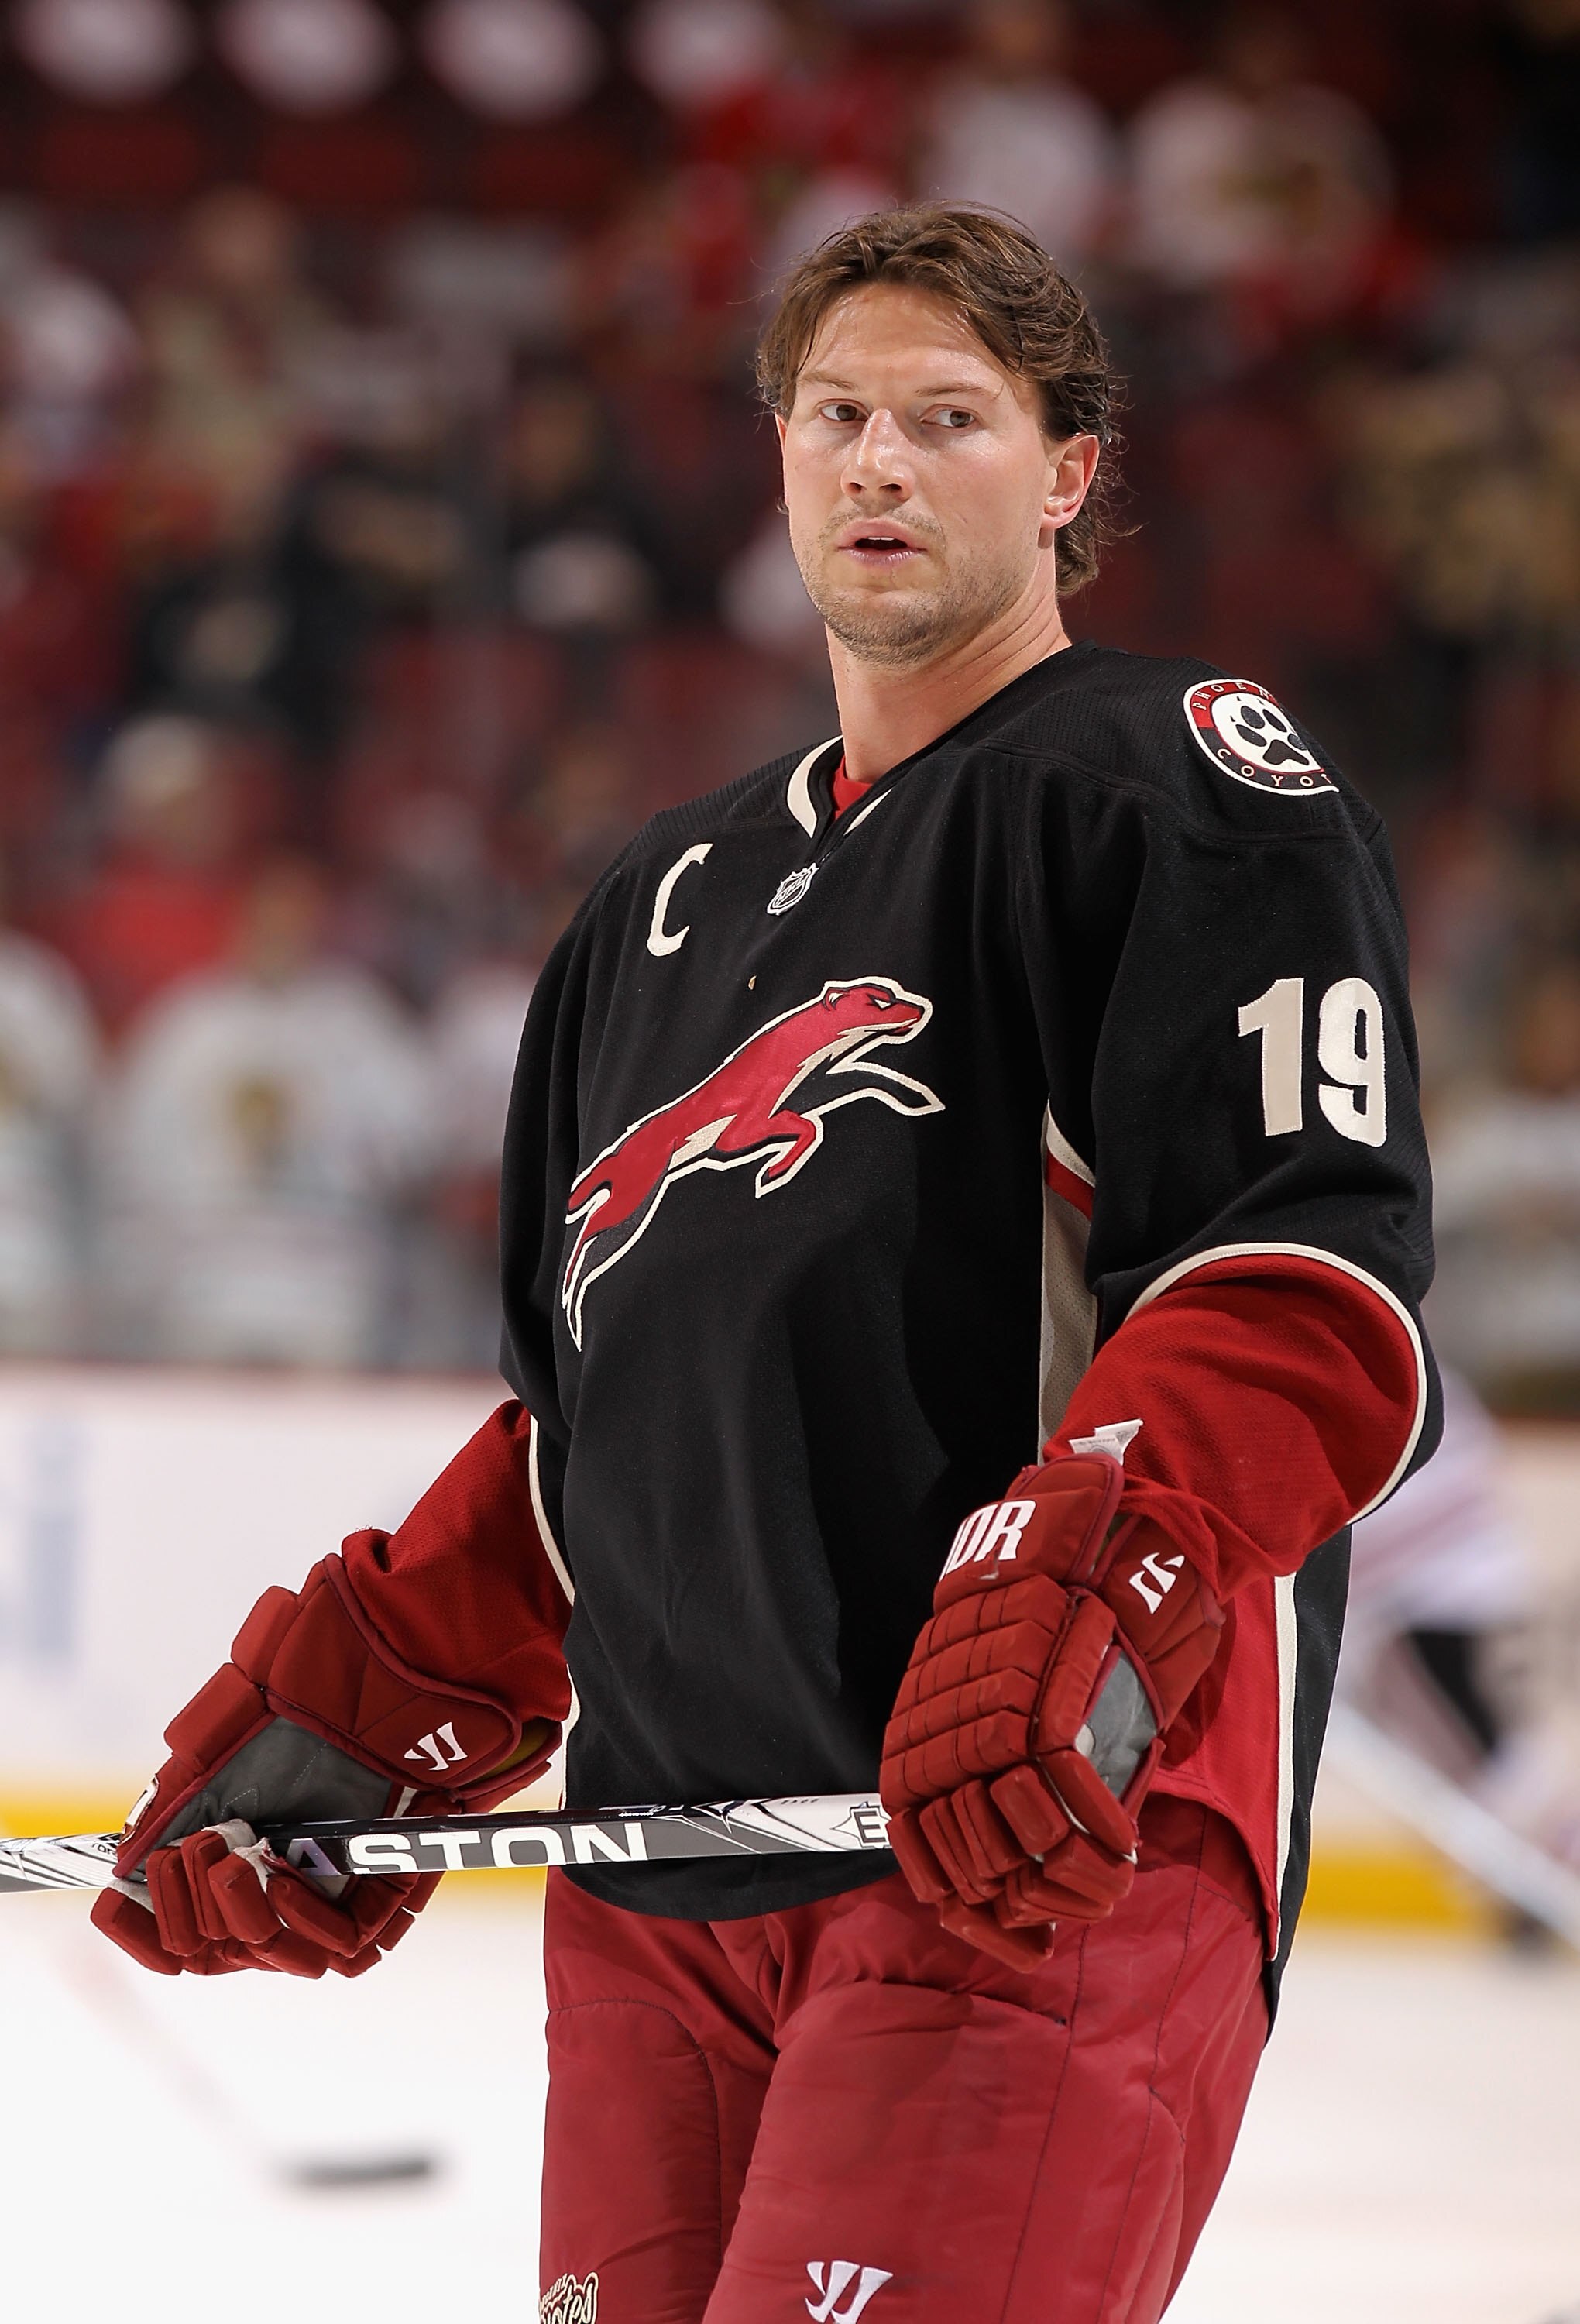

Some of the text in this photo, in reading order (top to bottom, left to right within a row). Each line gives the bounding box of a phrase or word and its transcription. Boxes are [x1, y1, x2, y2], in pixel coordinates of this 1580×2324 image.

[647, 843, 713, 957] C
[1238, 977, 1387, 1147] 19
[287, 1821, 648, 1876] ASTON
